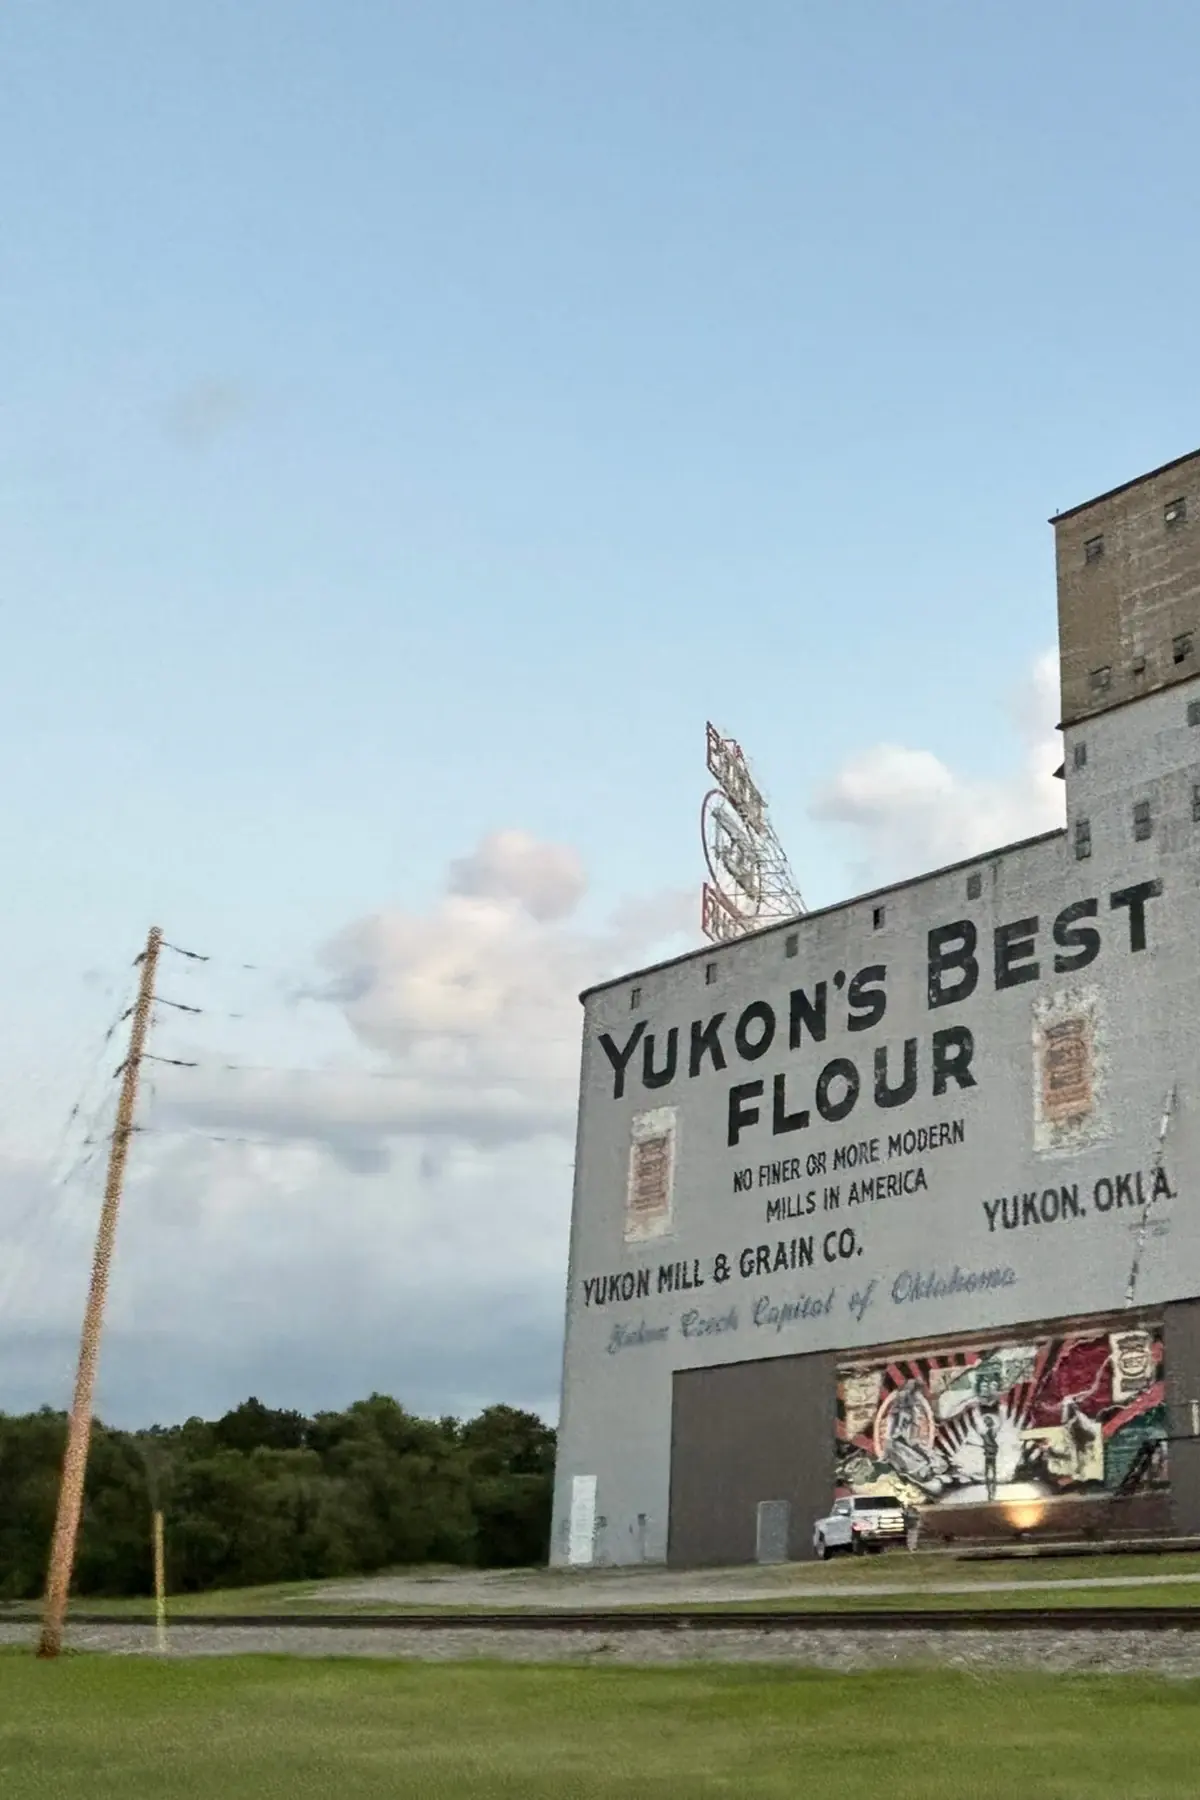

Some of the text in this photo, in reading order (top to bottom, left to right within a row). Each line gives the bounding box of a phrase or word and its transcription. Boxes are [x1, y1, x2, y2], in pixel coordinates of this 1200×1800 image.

[598, 878, 1163, 1099] YUKON'S BEST
[728, 1025, 977, 1146] FLOUR
[733, 1119, 965, 1192] NO FINER OR MORE MODERN
[1094, 1166, 1178, 1212] OKLA.
[766, 1167, 928, 1222] MILLS IN AMERICA
[582, 1228, 863, 1307] YUKON MILL & GRAIN CO.
[848, 1280, 876, 1322] of
[891, 1266, 1018, 1304] Oklahoma
